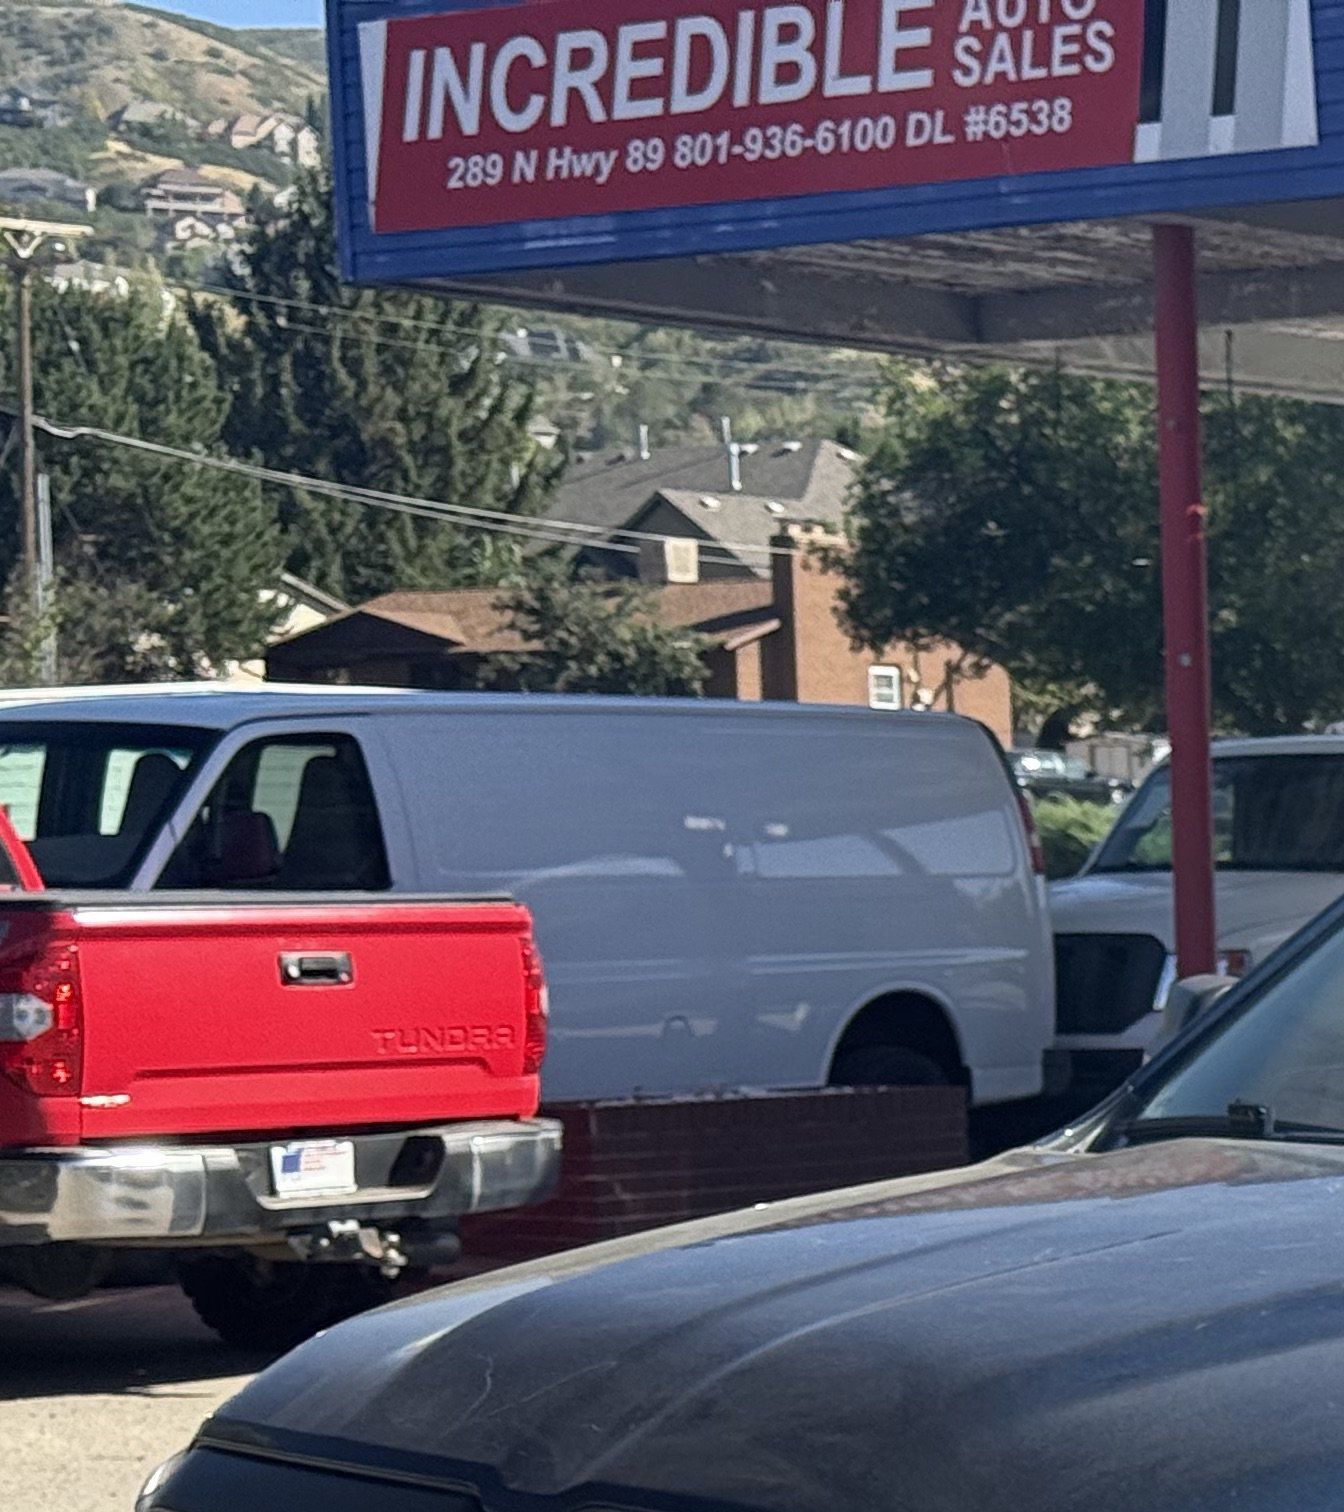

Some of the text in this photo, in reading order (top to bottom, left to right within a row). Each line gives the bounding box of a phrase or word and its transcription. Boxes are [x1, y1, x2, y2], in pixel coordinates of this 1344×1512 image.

[402, 0, 935, 142] INCREDIBLE
[952, 20, 1115, 88] SALES
[446, 96, 1073, 189] 289 N Hwy 89 801-936-6100 DL #6538
[370, 1024, 516, 1055] TUNDRA
